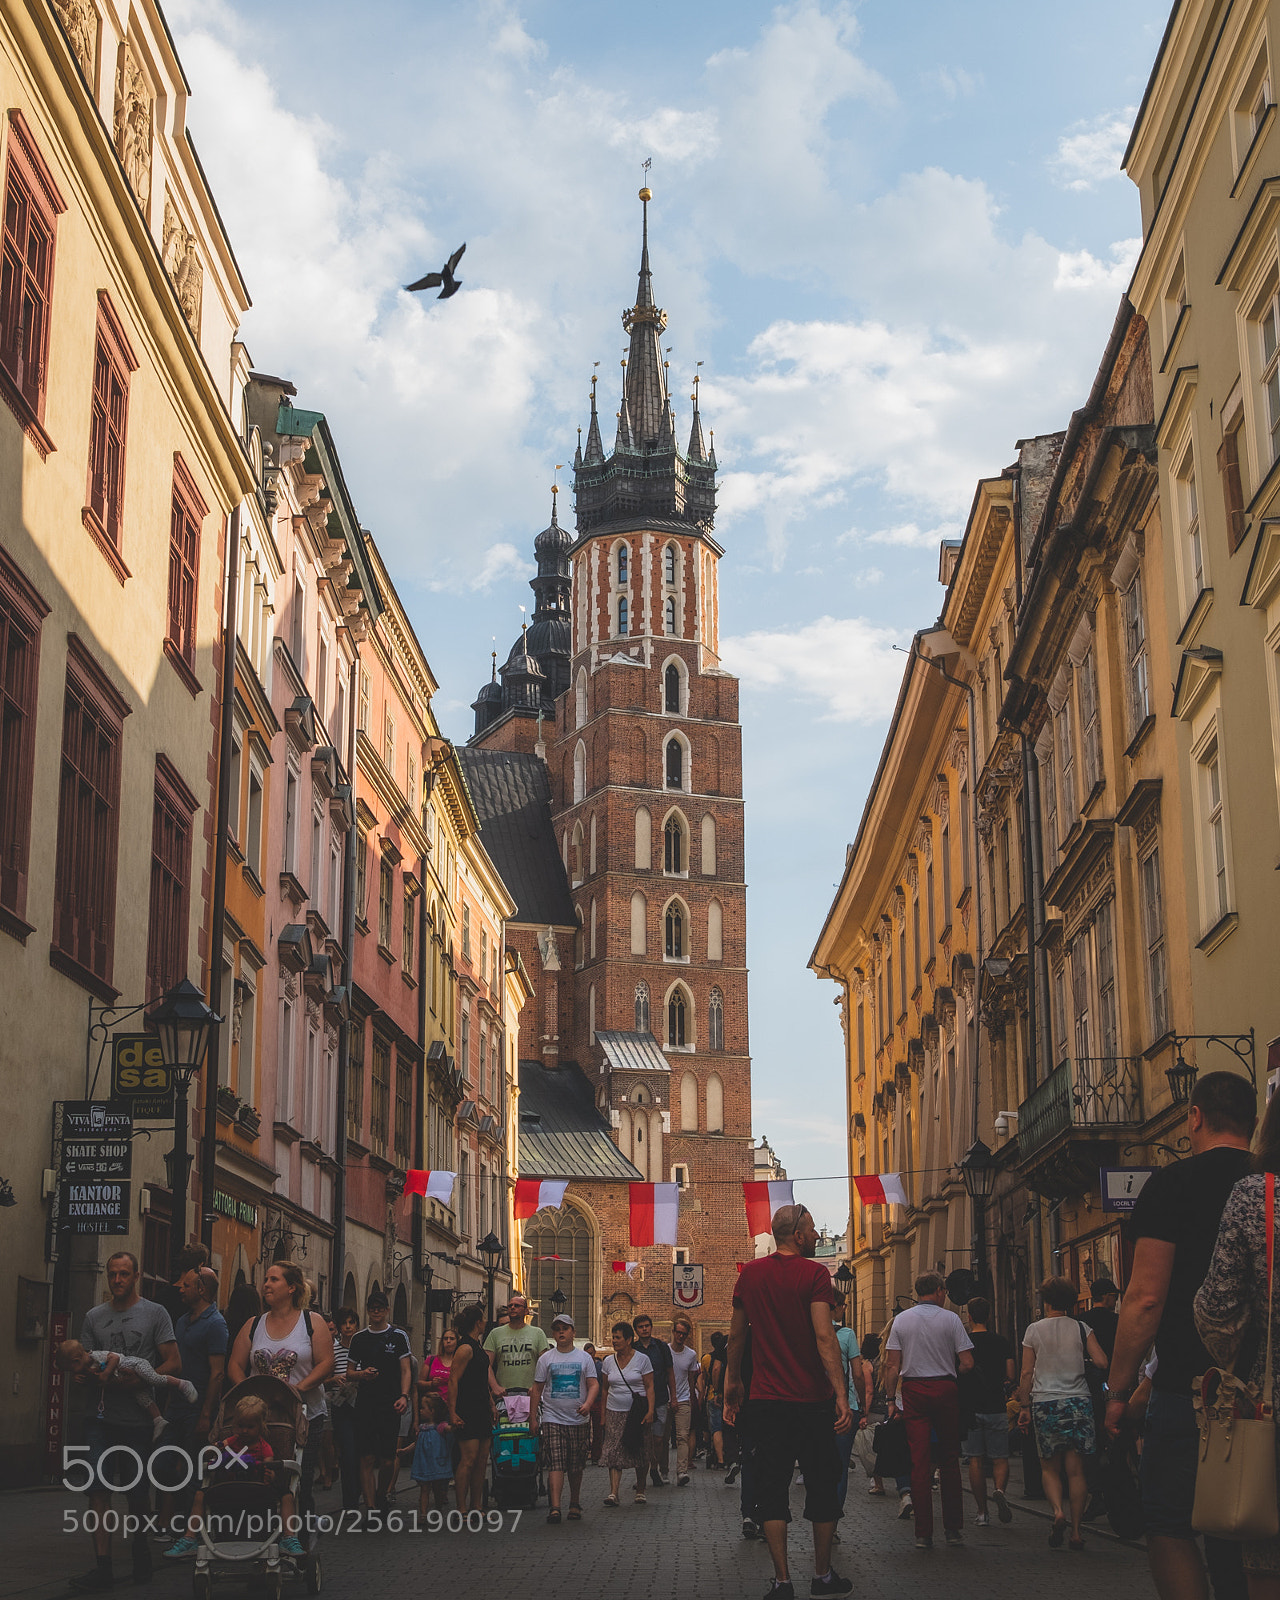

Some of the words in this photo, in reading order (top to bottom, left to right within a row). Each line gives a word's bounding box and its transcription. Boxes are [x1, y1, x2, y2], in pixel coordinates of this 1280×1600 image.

[119, 1042, 164, 1067] de
[119, 1068, 166, 1087] sa
[66, 1114, 90, 1125] VIVA
[105, 1116, 131, 1125] PINTA
[66, 1145, 97, 1157] SKATE
[99, 1145, 128, 1157] SHOP
[78, 1163, 95, 1171] VANS
[69, 1185, 122, 1201] KANTOR
[68, 1202, 121, 1215] EXCHANGE
[77, 1222, 110, 1233] HOSTEL
[501, 1343, 533, 1353] FIVE
[502, 1357, 532, 1367] THREE
